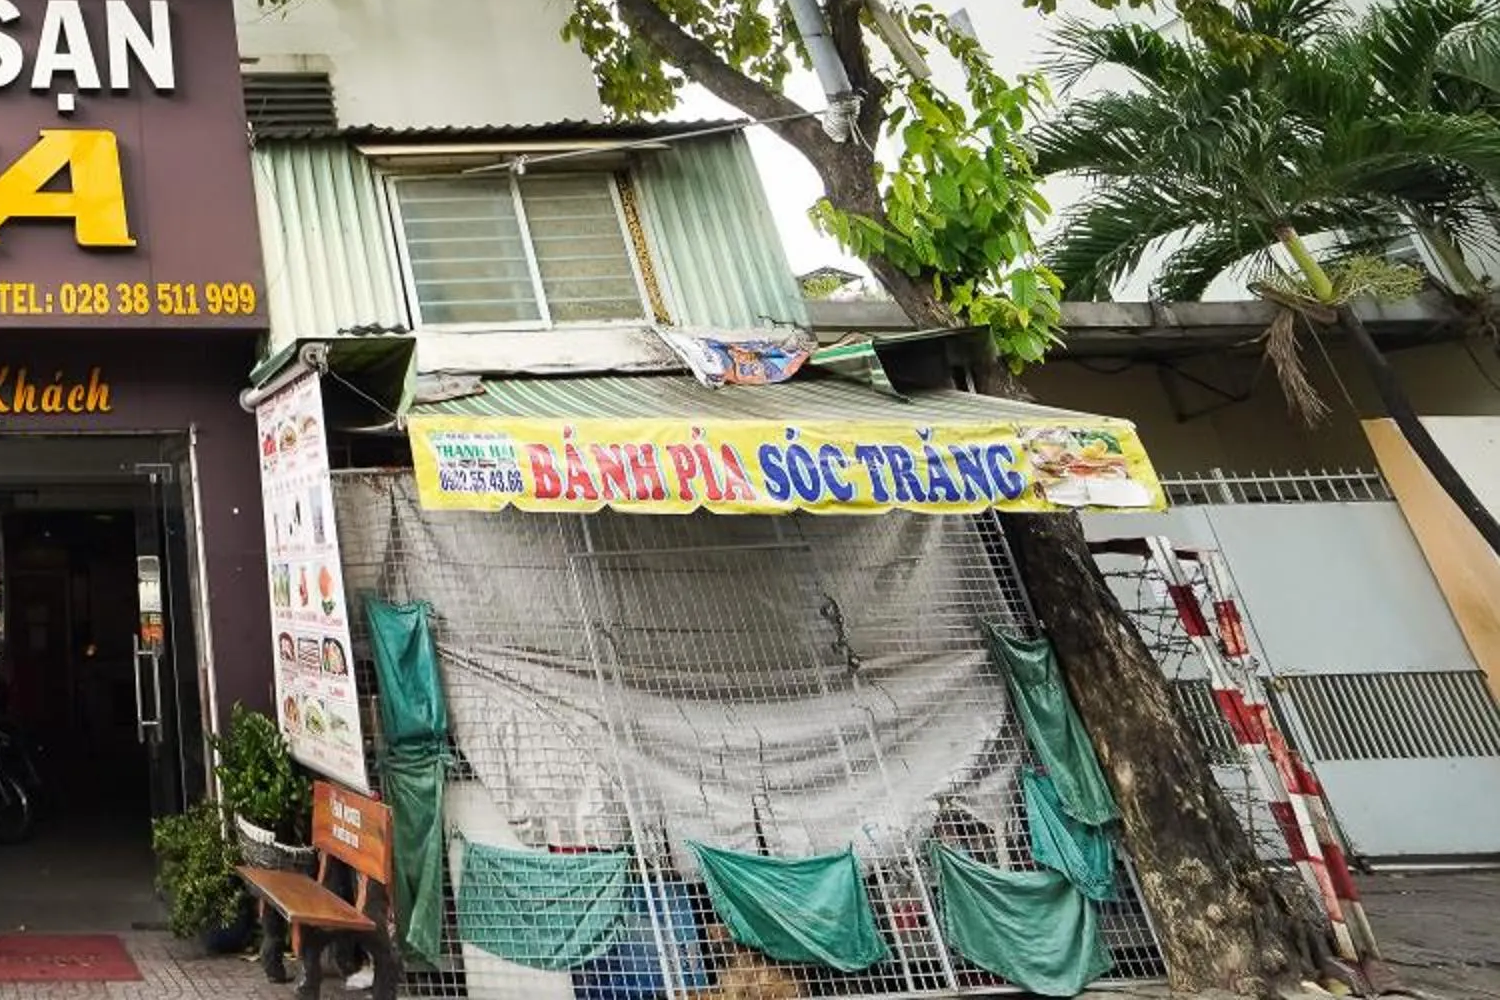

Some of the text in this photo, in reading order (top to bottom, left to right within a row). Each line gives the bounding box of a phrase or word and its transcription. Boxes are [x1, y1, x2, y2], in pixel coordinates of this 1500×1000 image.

[59, 283, 108, 315] 028
[117, 283, 149, 315] 38
[157, 283, 200, 315] 511
[205, 283, 257, 315] 999
[526, 426, 666, 501] BÁNH
[854, 427, 1026, 504] TRĂNG
